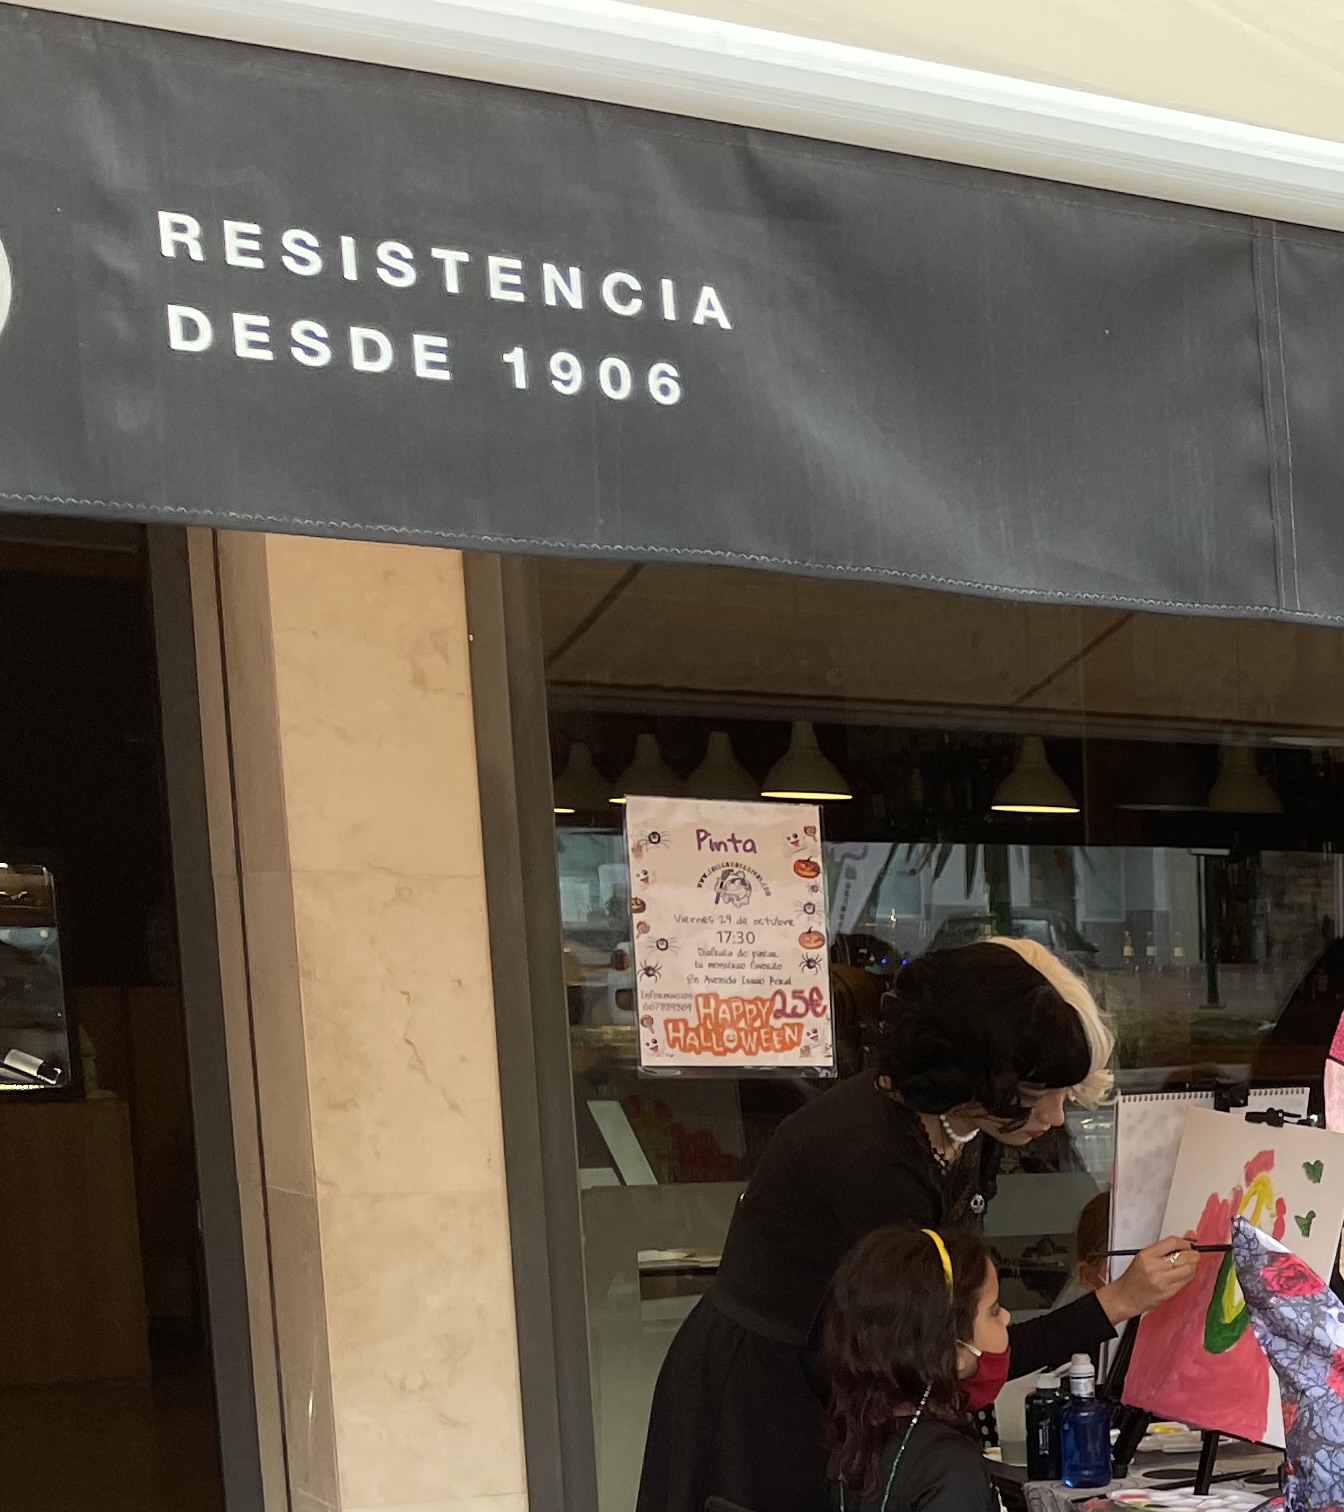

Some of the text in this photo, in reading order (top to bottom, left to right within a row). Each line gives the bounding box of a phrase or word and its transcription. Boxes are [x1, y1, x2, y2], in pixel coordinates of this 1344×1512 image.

[156, 208, 735, 332] RESISTENCIA
[165, 303, 685, 406] DESDE 1906
[695, 828, 758, 854] Pinta
[673, 913, 715, 925] Viernes
[718, 914, 732, 922] 29
[736, 915, 749, 926] de
[715, 930, 756, 945] 17:30
[697, 994, 773, 1025] HAPPY
[666, 1020, 803, 1054] HALLOWEEN
